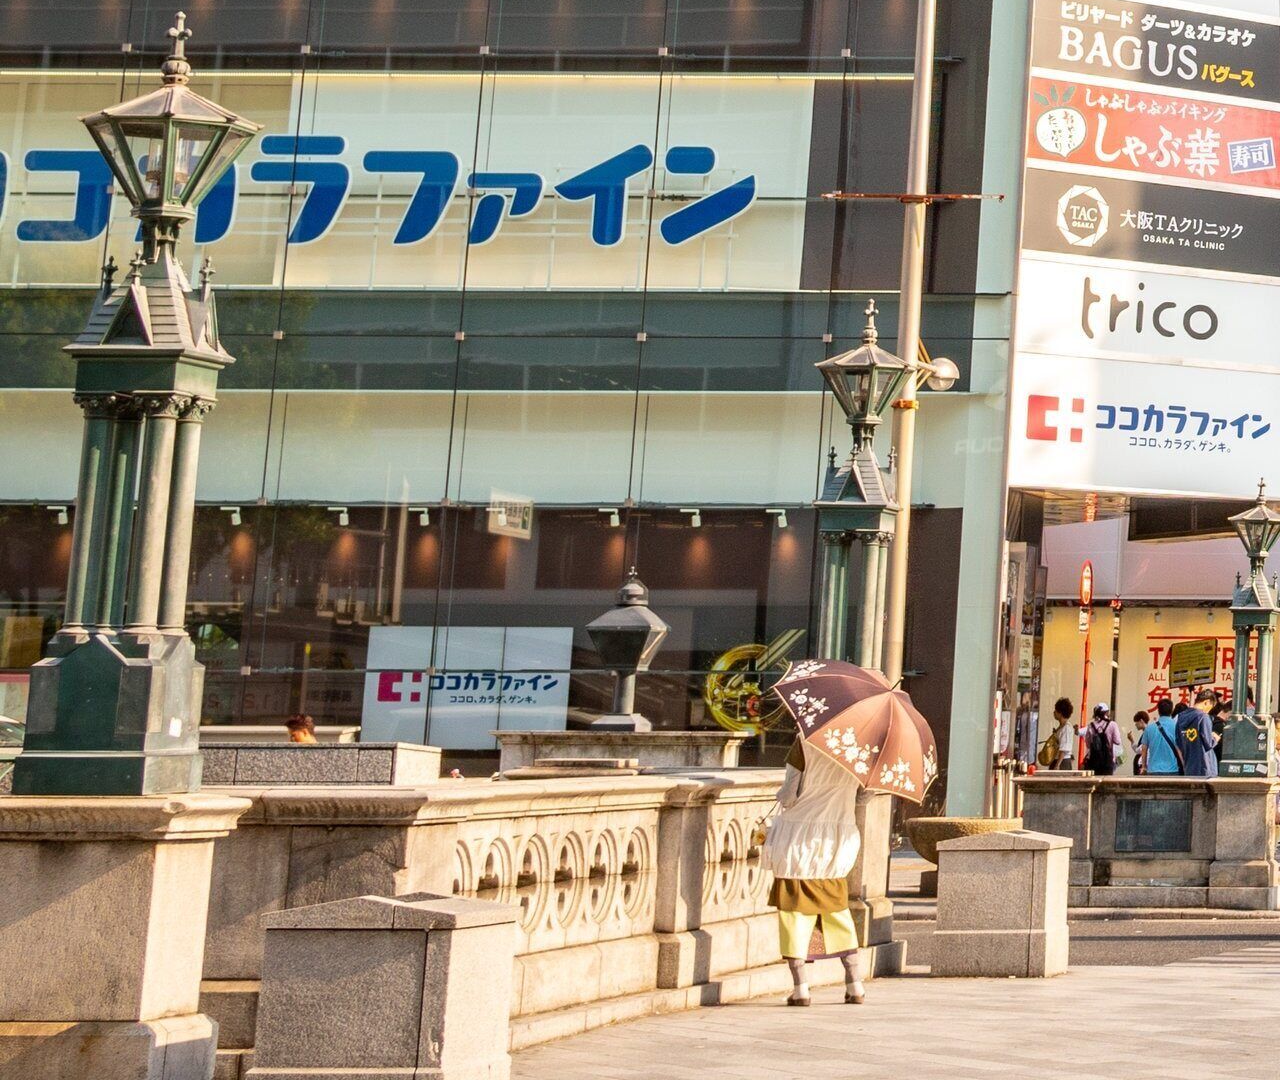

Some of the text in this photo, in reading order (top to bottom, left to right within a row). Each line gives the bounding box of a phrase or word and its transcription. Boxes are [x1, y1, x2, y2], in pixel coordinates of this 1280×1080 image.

[1060, 0, 1256, 47] ビリヤード ダーツ&カラオケ
[1058, 25, 1198, 81] BAGUS
[1201, 64, 1256, 89] バグース
[1085, 87, 1228, 123] しゃぶしゃぶバイキング
[1094, 112, 1221, 178] しゃぶ葉
[1231, 141, 1271, 170] 寿司
[0, 133, 758, 248] コカラファイン
[1069, 205, 1098, 223] TAC
[1119, 209, 1244, 240] 大阪TAクリニック
[1142, 234, 1226, 252] OSAKA TA CLINIC
[1080, 275, 1219, 341] trico
[1095, 403, 1271, 440] ココカラファイン
[1128, 435, 1231, 454] ココロ、カラダ、ゲンキ。
[429, 672, 559, 691] ココカラファイン
[449, 695, 537, 704] ココロ、カラダ、ゲンキ。
